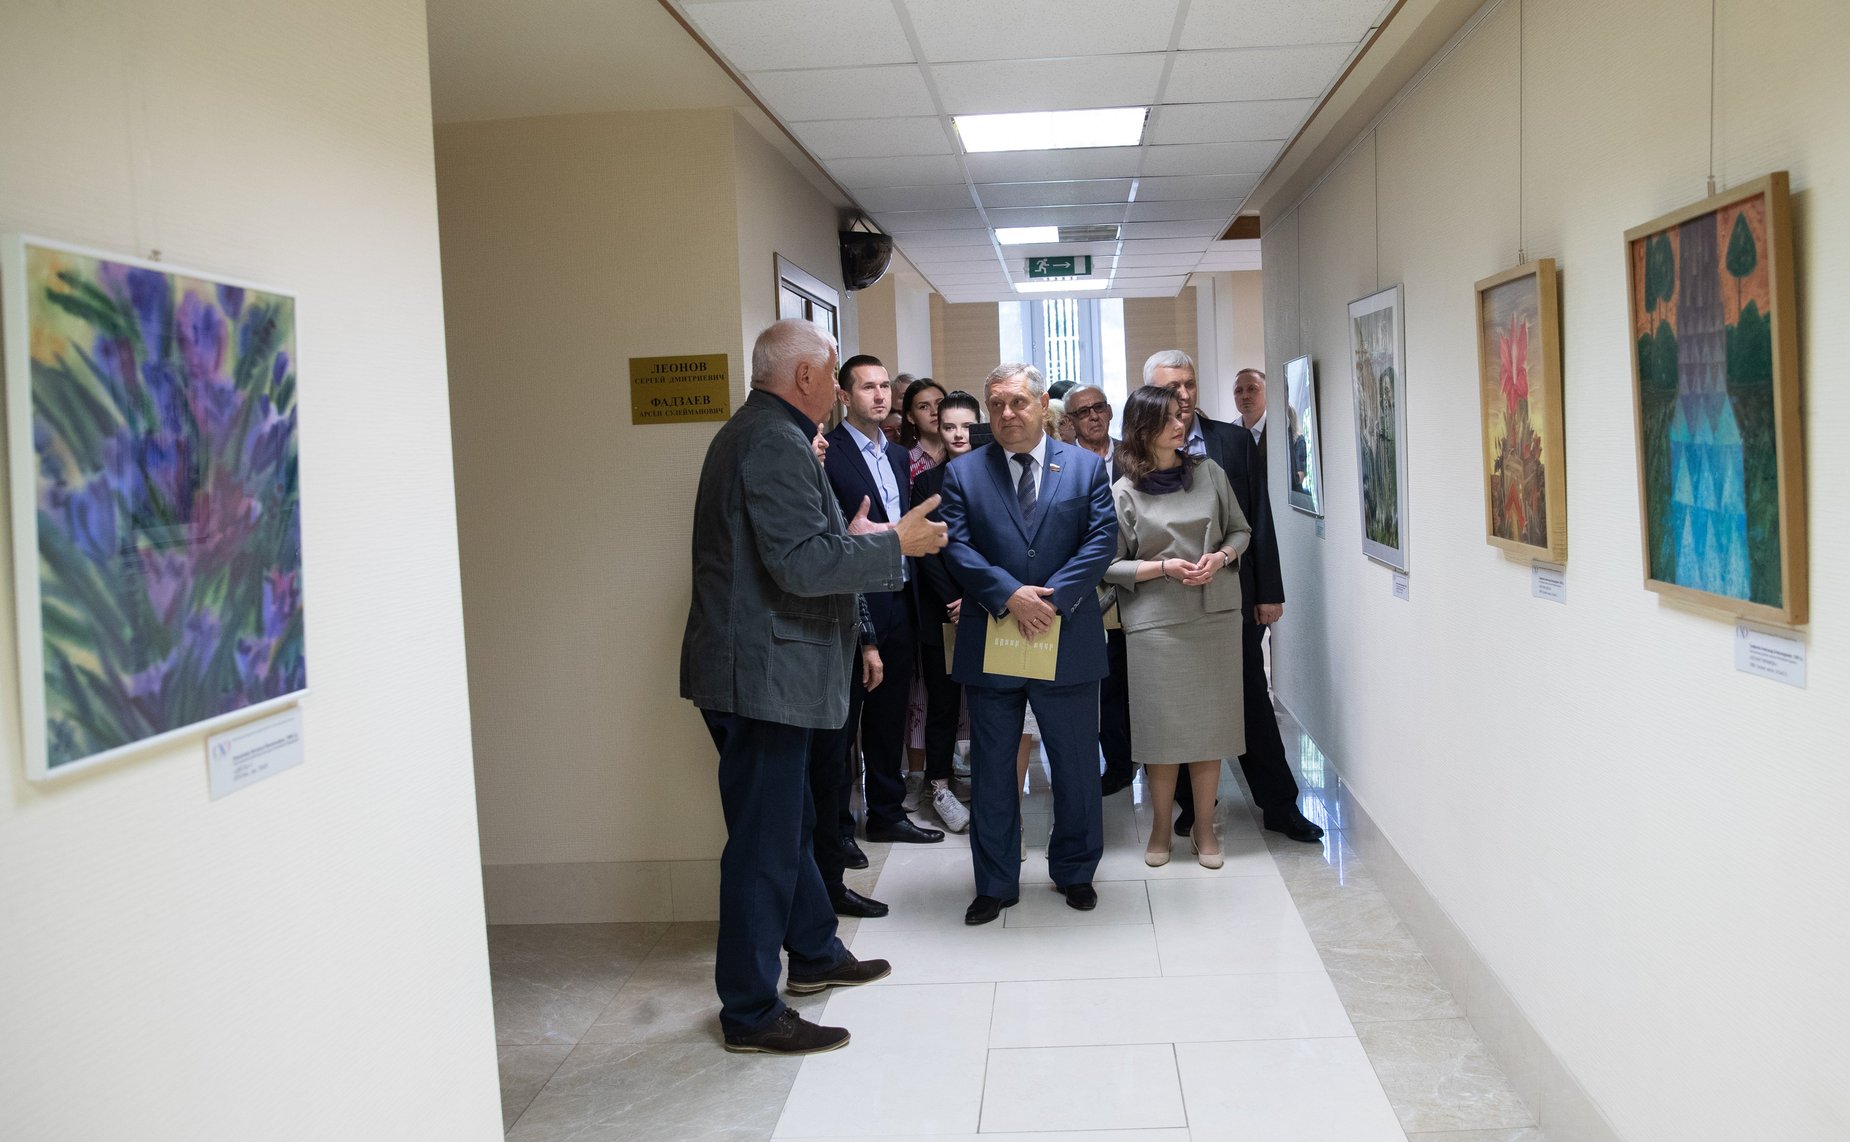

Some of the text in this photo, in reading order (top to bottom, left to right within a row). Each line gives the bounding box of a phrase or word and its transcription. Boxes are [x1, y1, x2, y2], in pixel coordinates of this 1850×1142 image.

[651, 362, 707, 374] ЛЕОНОВ
[634, 374, 725, 385] СЕРГЕЙ ДМИТРИЕВИЧ
[650, 395, 711, 407] ФАДЗАЕВ
